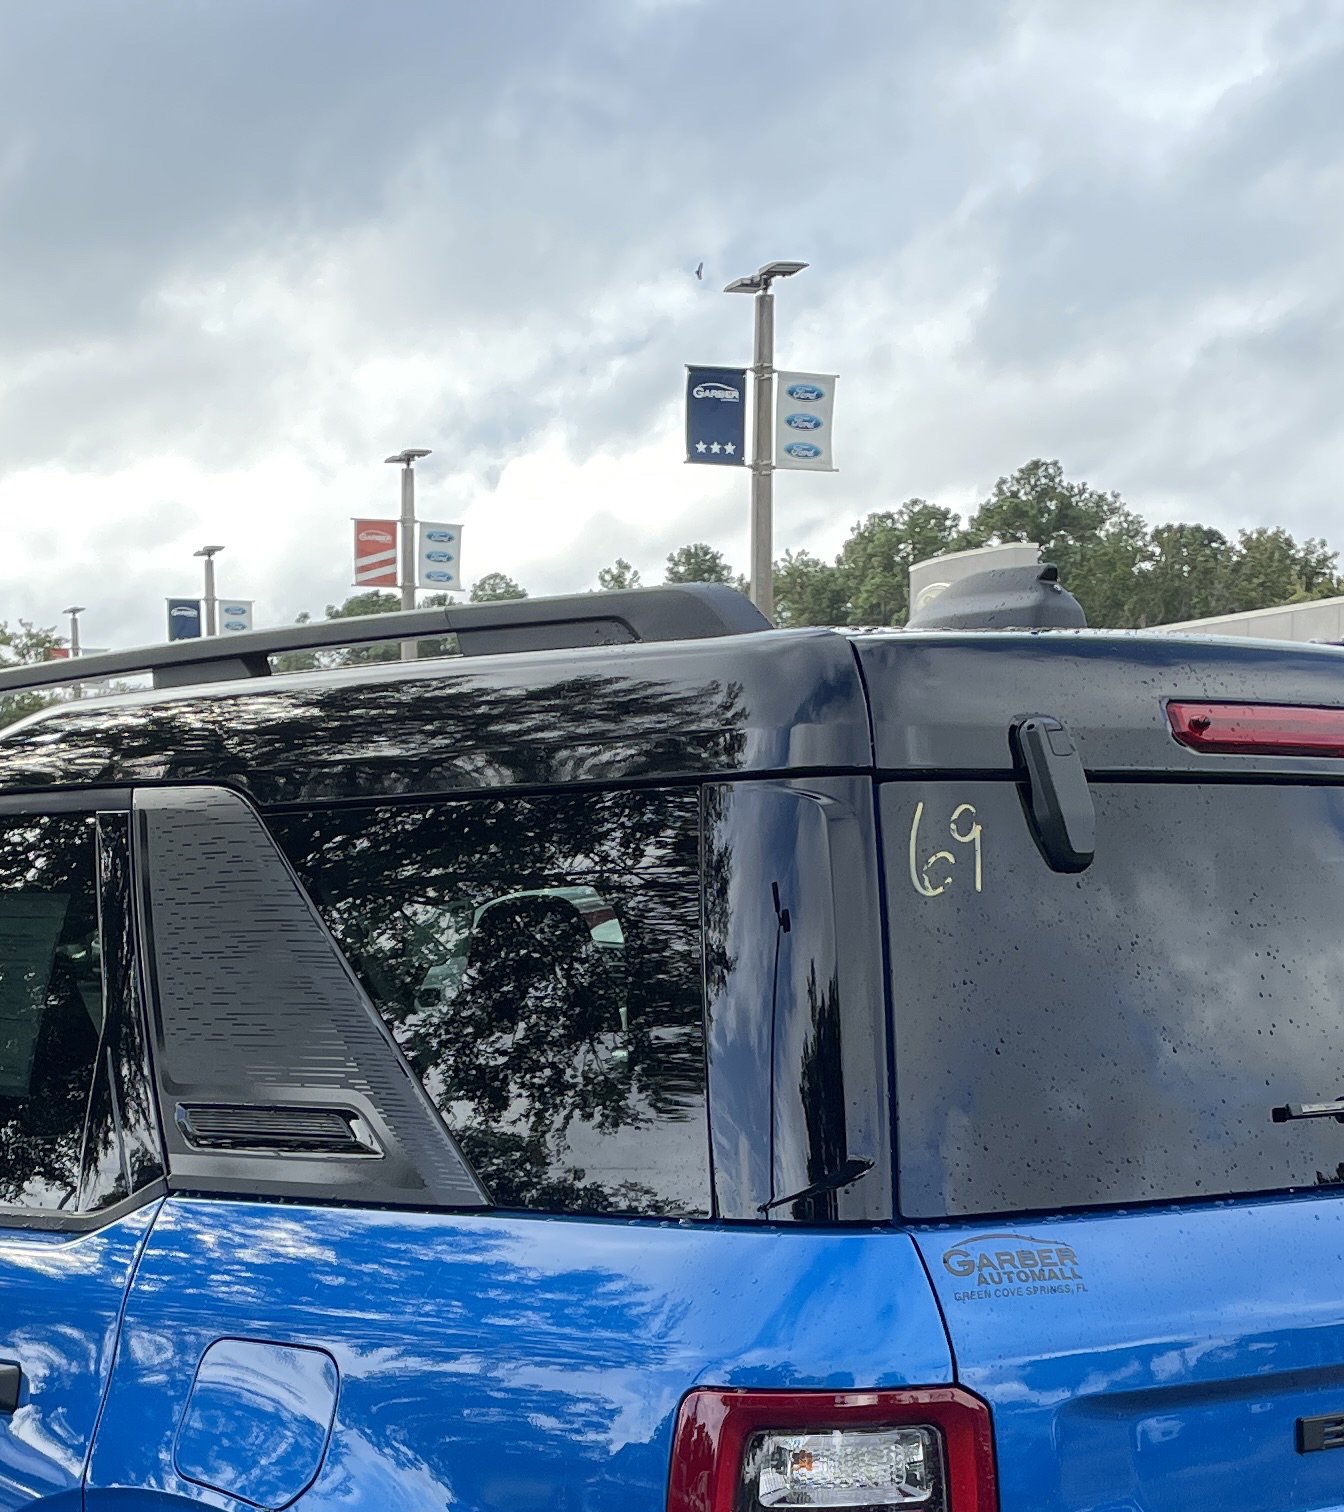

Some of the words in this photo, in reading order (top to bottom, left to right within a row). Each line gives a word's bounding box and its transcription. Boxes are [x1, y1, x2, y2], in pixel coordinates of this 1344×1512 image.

[908, 801, 983, 897] 69
[942, 1247, 1080, 1277] GARBER
[976, 1267, 1084, 1287] AUTOMALL
[953, 1290, 992, 1303] GREEN
[993, 1286, 1024, 1299] COVE
[1076, 1283, 1089, 1294] FL
